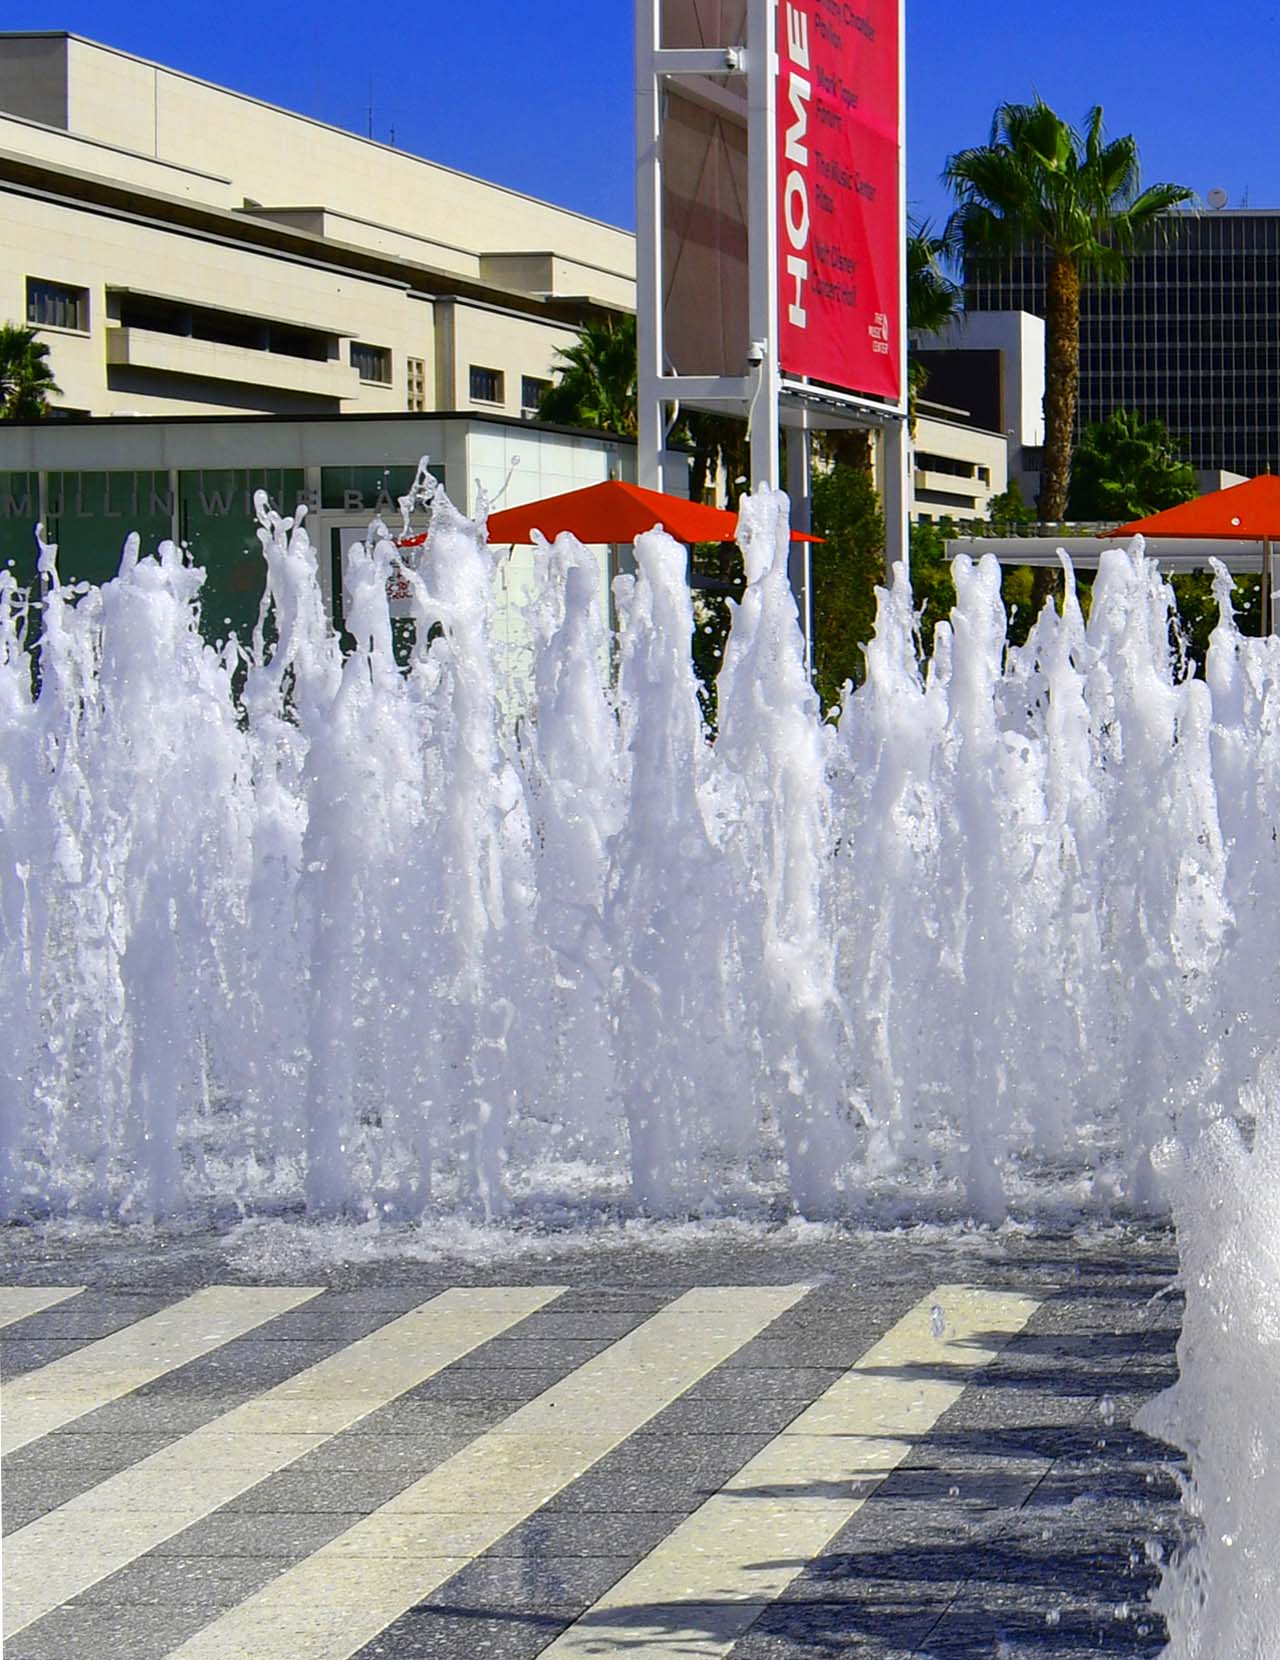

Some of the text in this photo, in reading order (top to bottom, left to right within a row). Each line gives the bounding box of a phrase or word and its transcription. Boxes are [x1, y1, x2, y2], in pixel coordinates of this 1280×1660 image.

[785, 1, 811, 328] HOME
[4, 490, 175, 518] MULLIN
[198, 489, 320, 516] WINE
